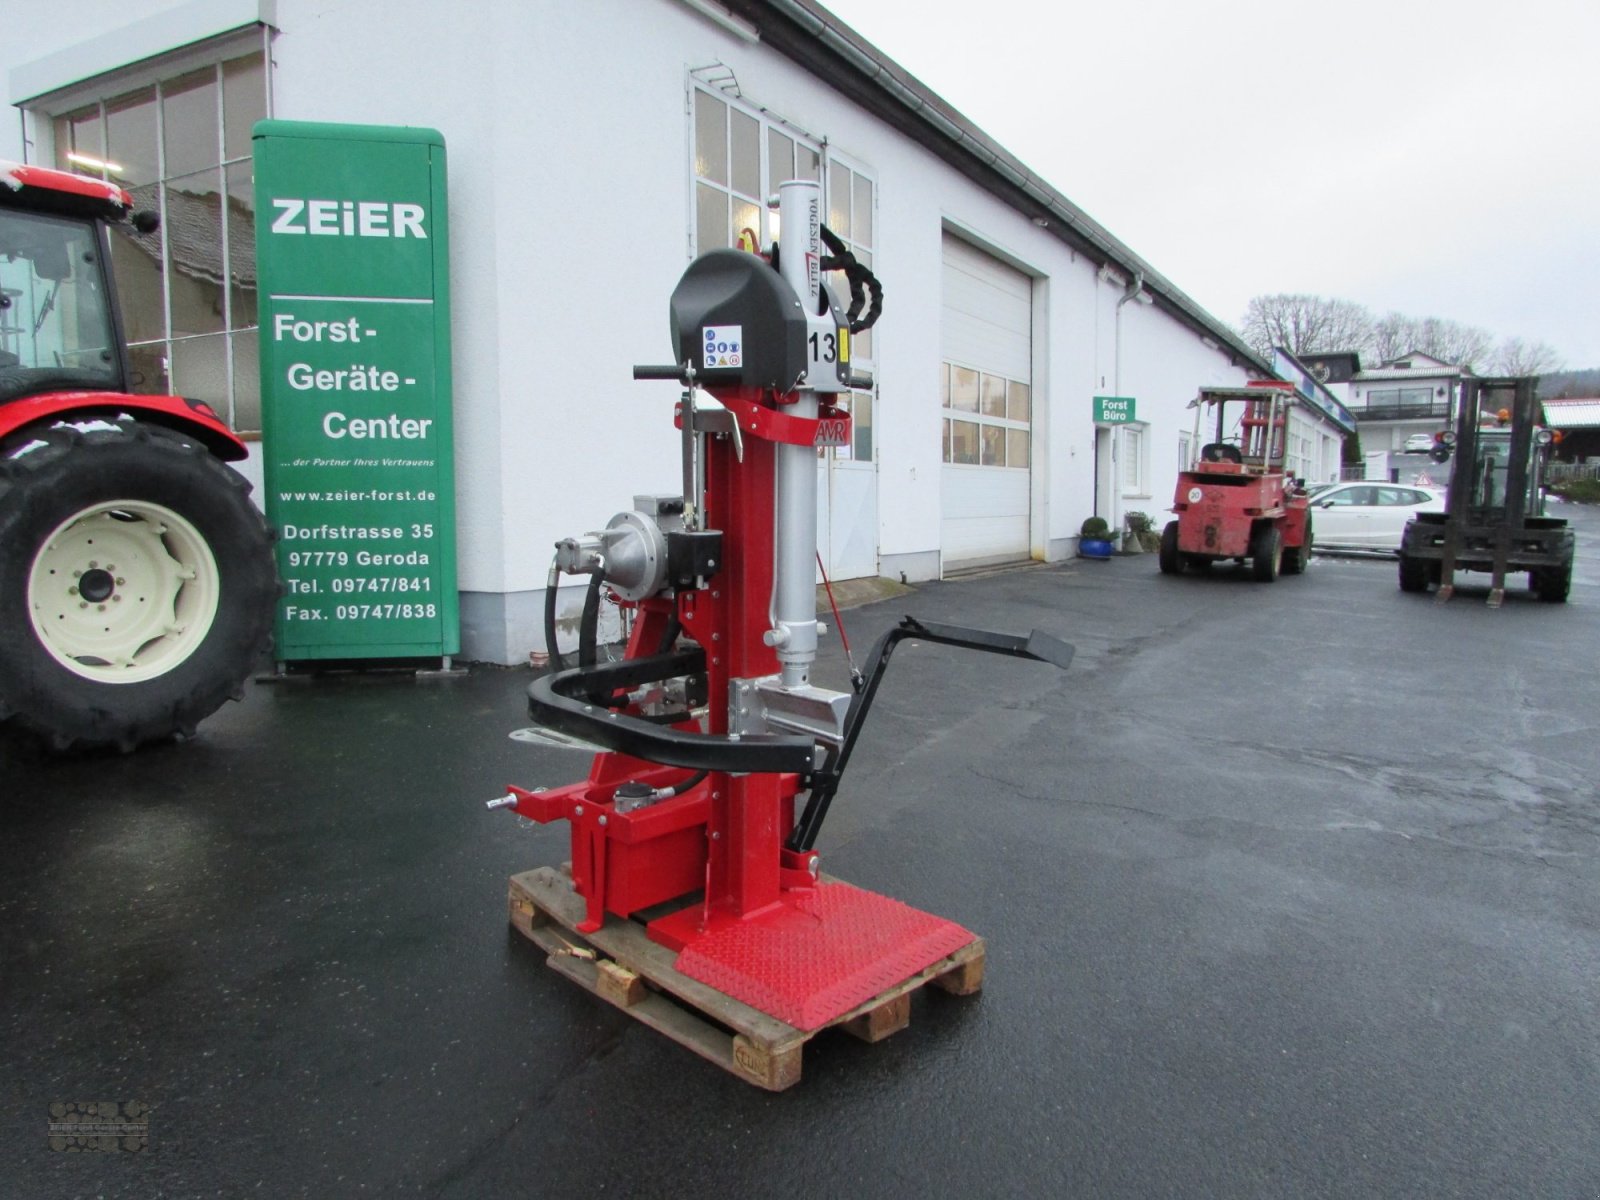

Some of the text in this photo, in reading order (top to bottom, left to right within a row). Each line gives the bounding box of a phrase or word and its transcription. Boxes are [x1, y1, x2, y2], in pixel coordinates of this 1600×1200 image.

[271, 199, 428, 239] ZEiER
[809, 198, 818, 254] VOGESEN
[809, 331, 836, 362] 13
[1102, 400, 1128, 410] Forst
[1103, 410, 1126, 420] Büro
[323, 412, 432, 439] Center
[313, 458, 350, 467] Partner
[353, 458, 379, 467] Ihres
[382, 458, 435, 467] Vertrauens
[280, 490, 436, 502] www.zeier-forst.de
[283, 524, 434, 540] Dorfstrasse 35
[289, 551, 430, 566] 97779 Geroda
[288, 578, 431, 594] Tel. 09747/841
[286, 604, 436, 621] Fax. 09747/838
